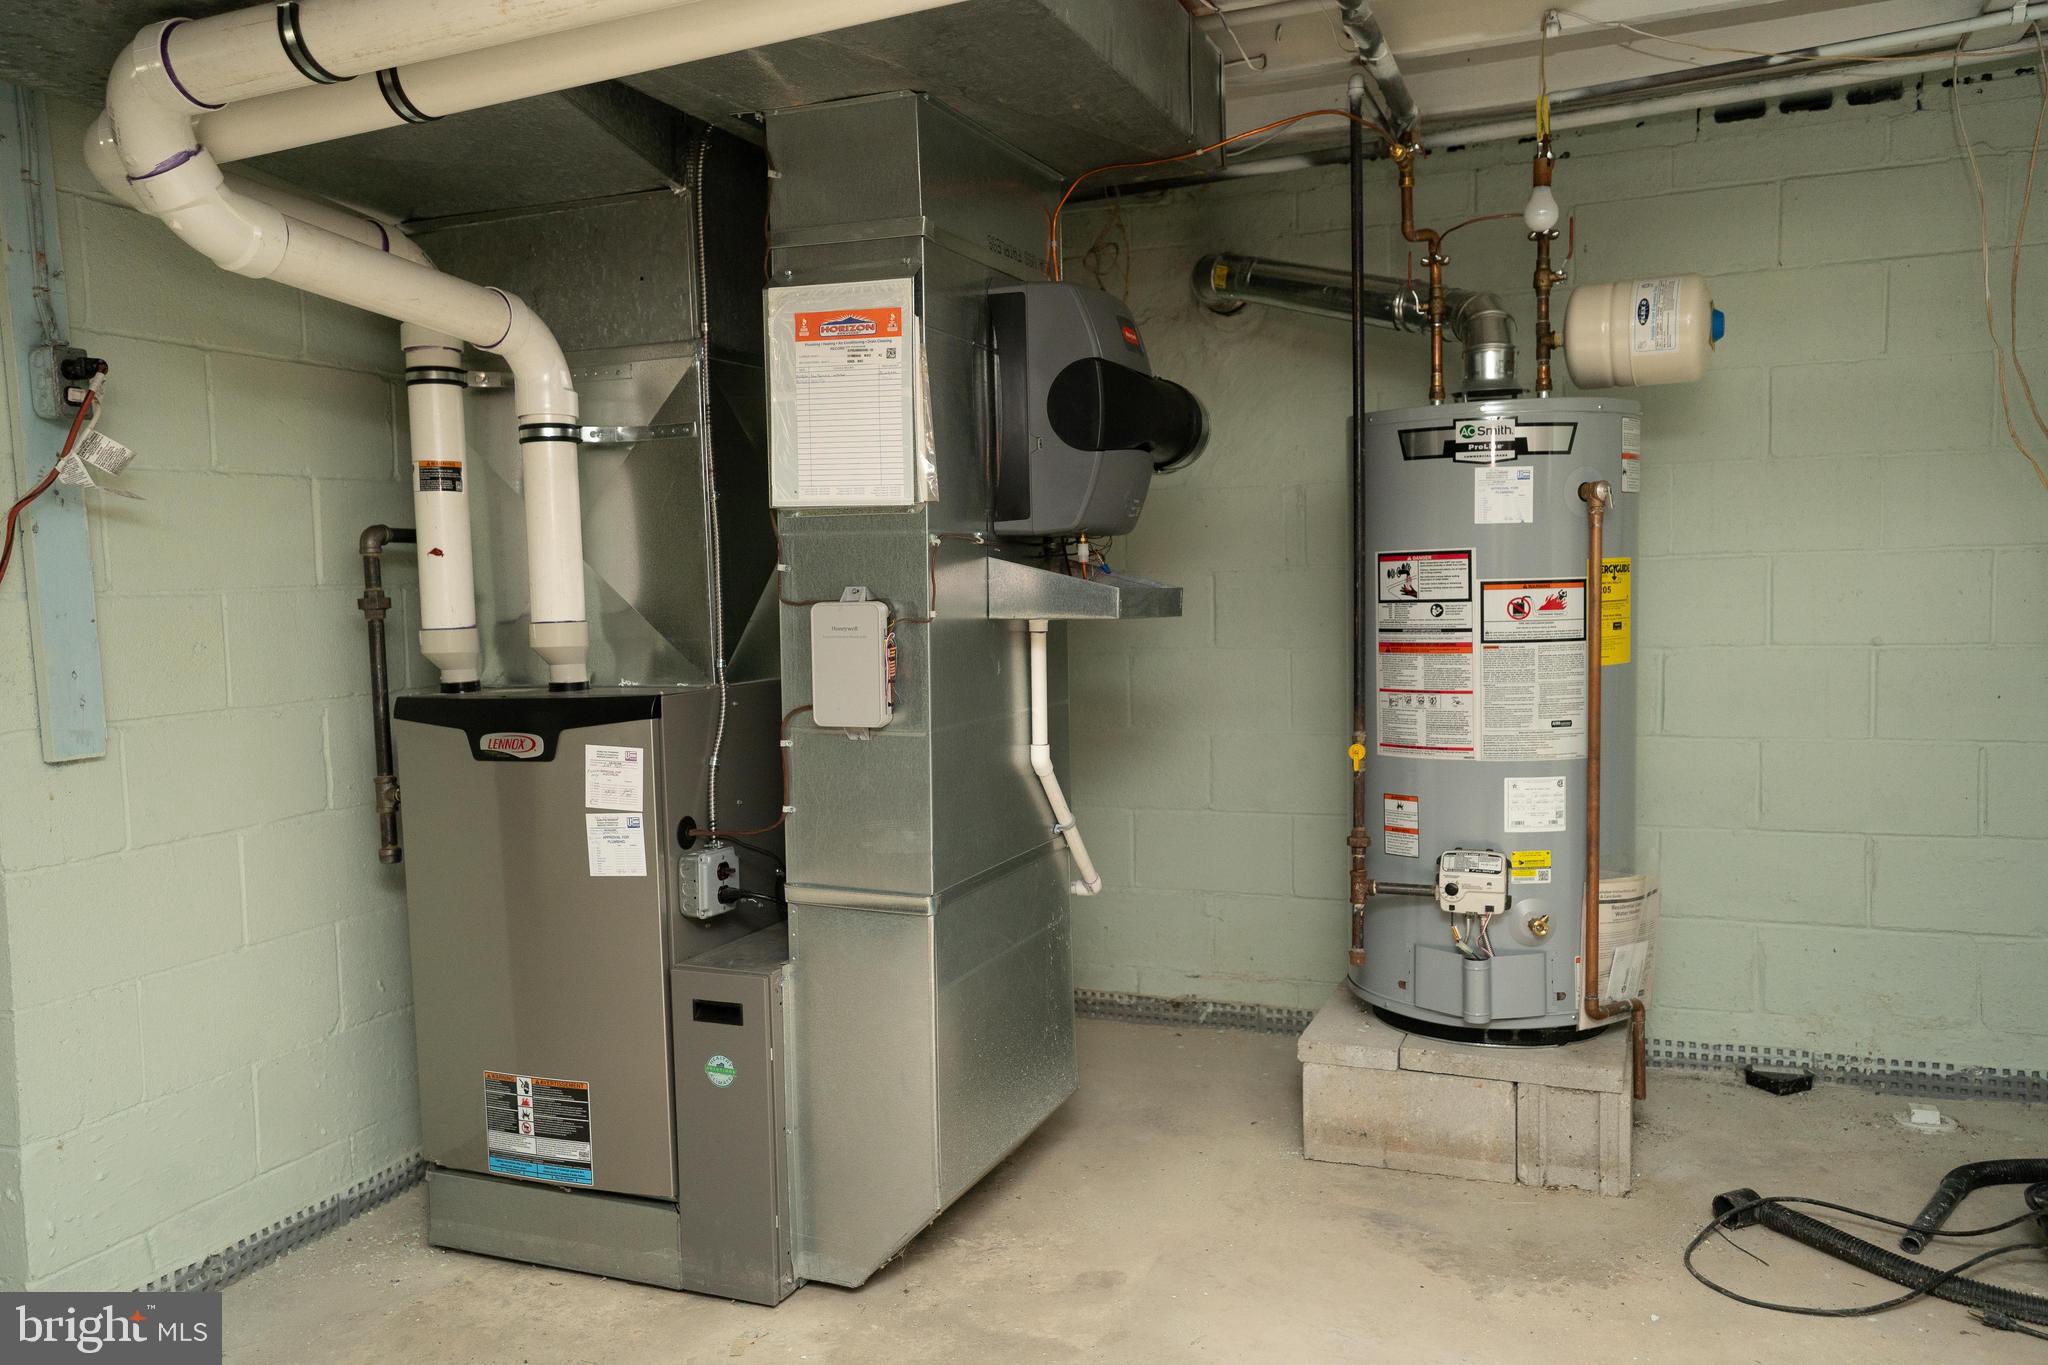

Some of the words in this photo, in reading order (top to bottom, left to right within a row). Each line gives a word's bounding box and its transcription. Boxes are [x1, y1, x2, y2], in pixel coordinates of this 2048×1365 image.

[821, 323, 875, 333] HORIZON
[1477, 425, 1512, 436] Smith
[1601, 564, 1630, 575] ERGYGUIDE
[488, 738, 526, 750] LENNOX
